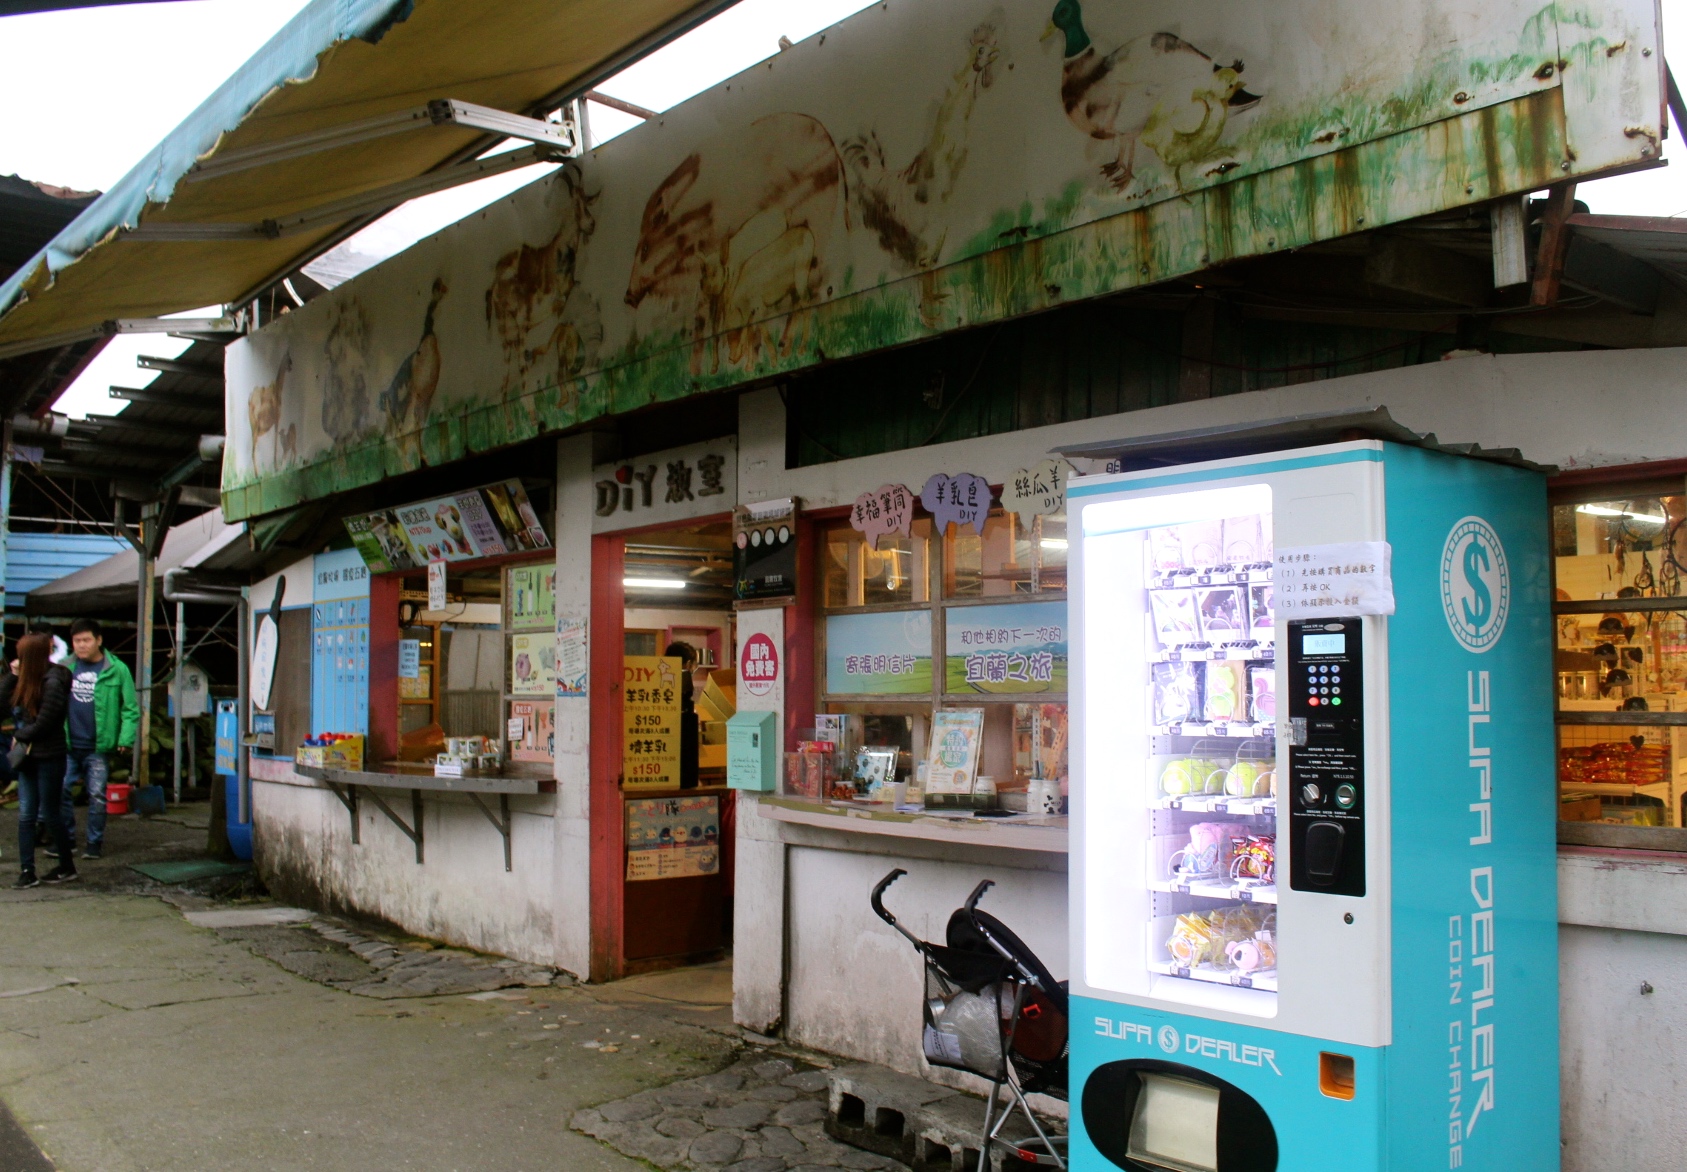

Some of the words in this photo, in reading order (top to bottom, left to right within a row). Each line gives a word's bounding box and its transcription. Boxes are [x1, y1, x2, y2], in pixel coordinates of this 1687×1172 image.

[936, 482, 978, 507] 羊乳皂
[1044, 493, 1063, 508] DIY
[855, 487, 906, 524] 幸福筆筒
[887, 513, 903, 527] DIY
[959, 510, 977, 521] DIY
[1320, 583, 1331, 591] OK
[750, 643, 769, 660] 國內
[745, 660, 775, 677] 免費寄
[845, 654, 916, 675] 寄張明信片
[965, 652, 1052, 683] 宜蘭之旅
[624, 667, 655, 682] DIY
[626, 688, 674, 704] 羊乳香皂
[635, 715, 661, 726] $150
[1466, 670, 1492, 845] SUPA
[633, 763, 661, 775] $150
[1449, 915, 1462, 1004] COIN
[1466, 866, 1494, 1138] DEALER
[1095, 1016, 1152, 1045] SUPA
[1185, 1033, 1282, 1076] DEALER
[1449, 1020, 1463, 1170] CHANGE
